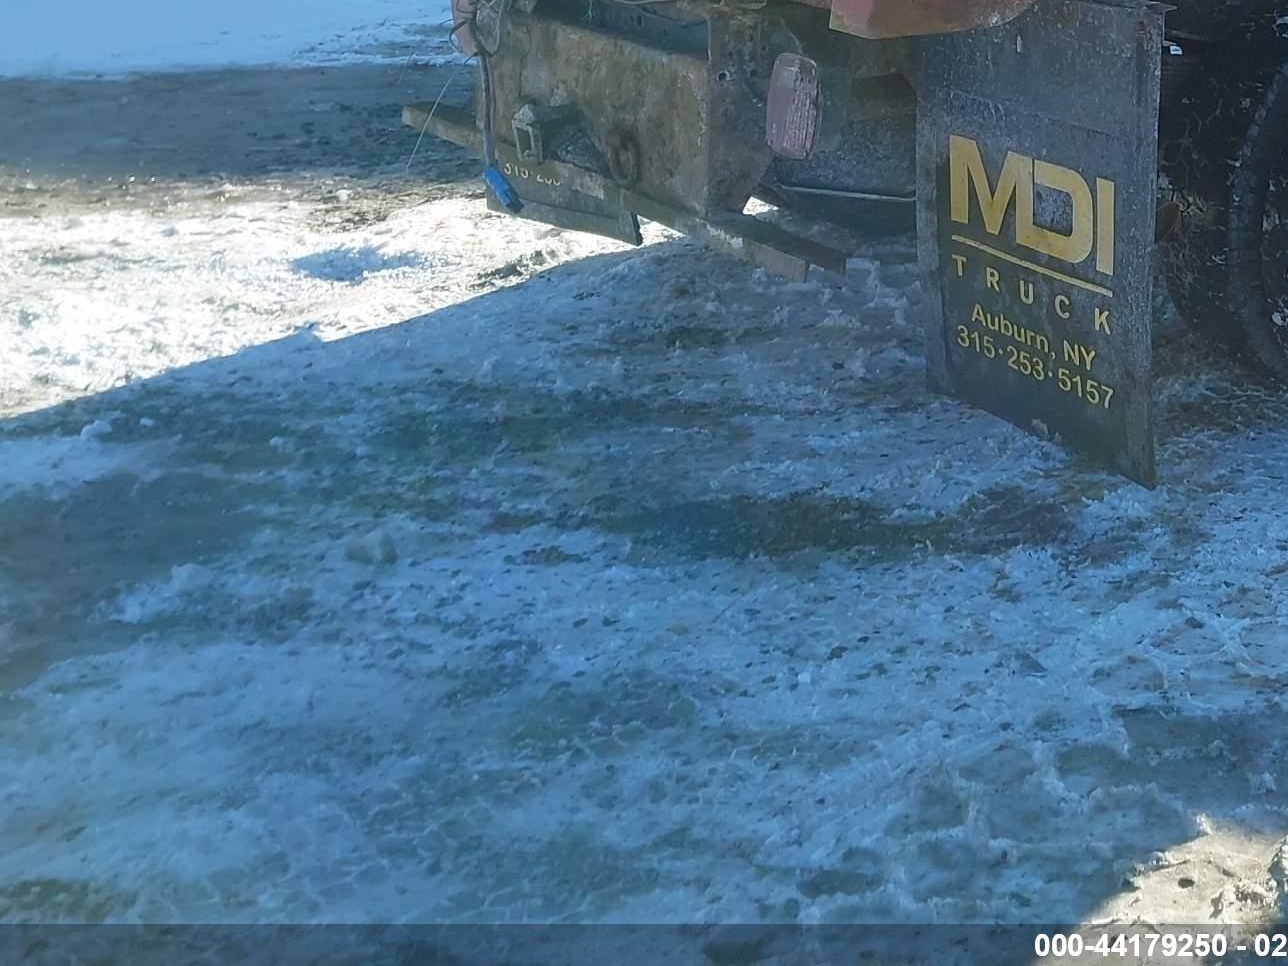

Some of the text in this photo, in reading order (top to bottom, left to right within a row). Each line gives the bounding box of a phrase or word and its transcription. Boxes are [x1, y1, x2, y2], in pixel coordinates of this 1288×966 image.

[950, 134, 1115, 276] MDI
[951, 253, 1111, 335] TRUCK
[971, 303, 1096, 372] Auburn, NY
